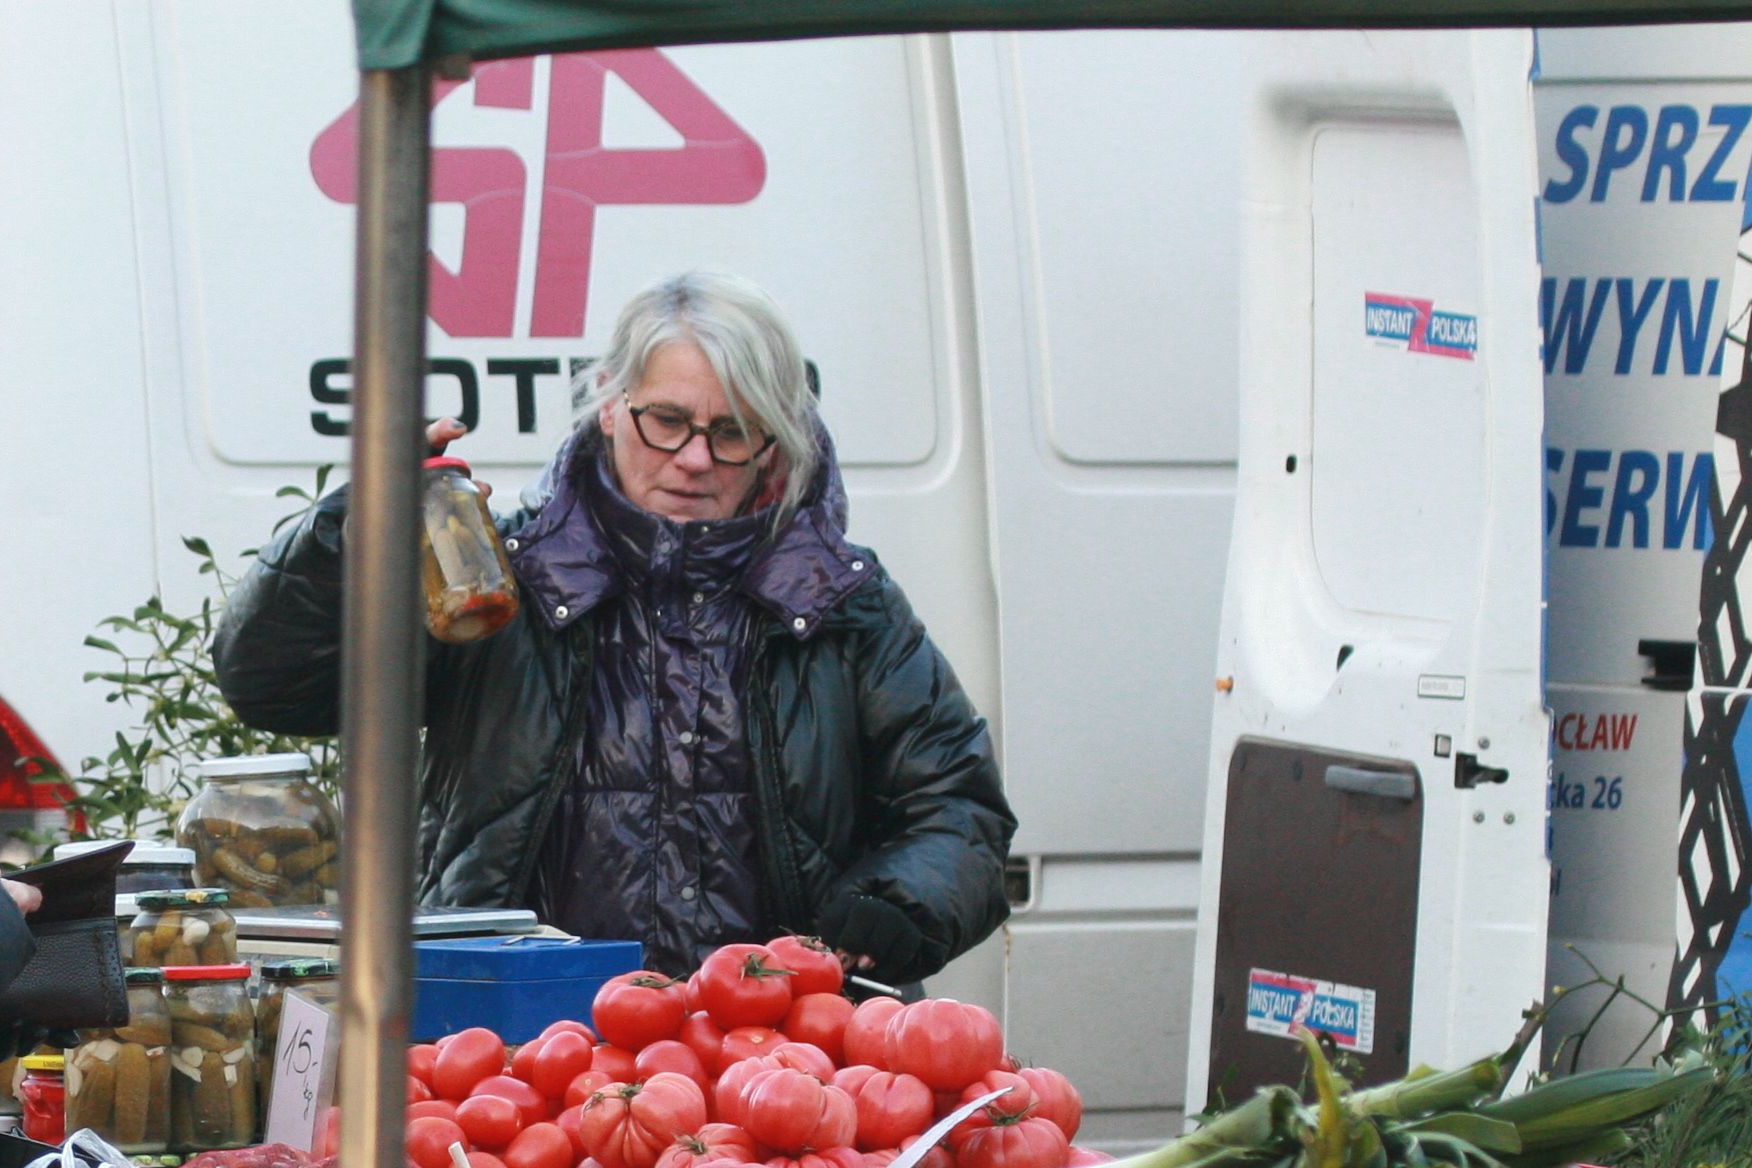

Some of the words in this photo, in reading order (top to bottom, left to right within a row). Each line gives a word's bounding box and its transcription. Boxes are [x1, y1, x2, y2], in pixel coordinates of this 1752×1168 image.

[1543, 103, 1752, 204] SPRZ
[1368, 307, 1413, 335] INSTANT
[1432, 315, 1476, 344] POLSKA
[1552, 713, 1638, 751] CŁAW
[1592, 776, 1622, 810] 26
[1251, 988, 1296, 1017] INSTANT
[1313, 1001, 1355, 1029] POLSKA
